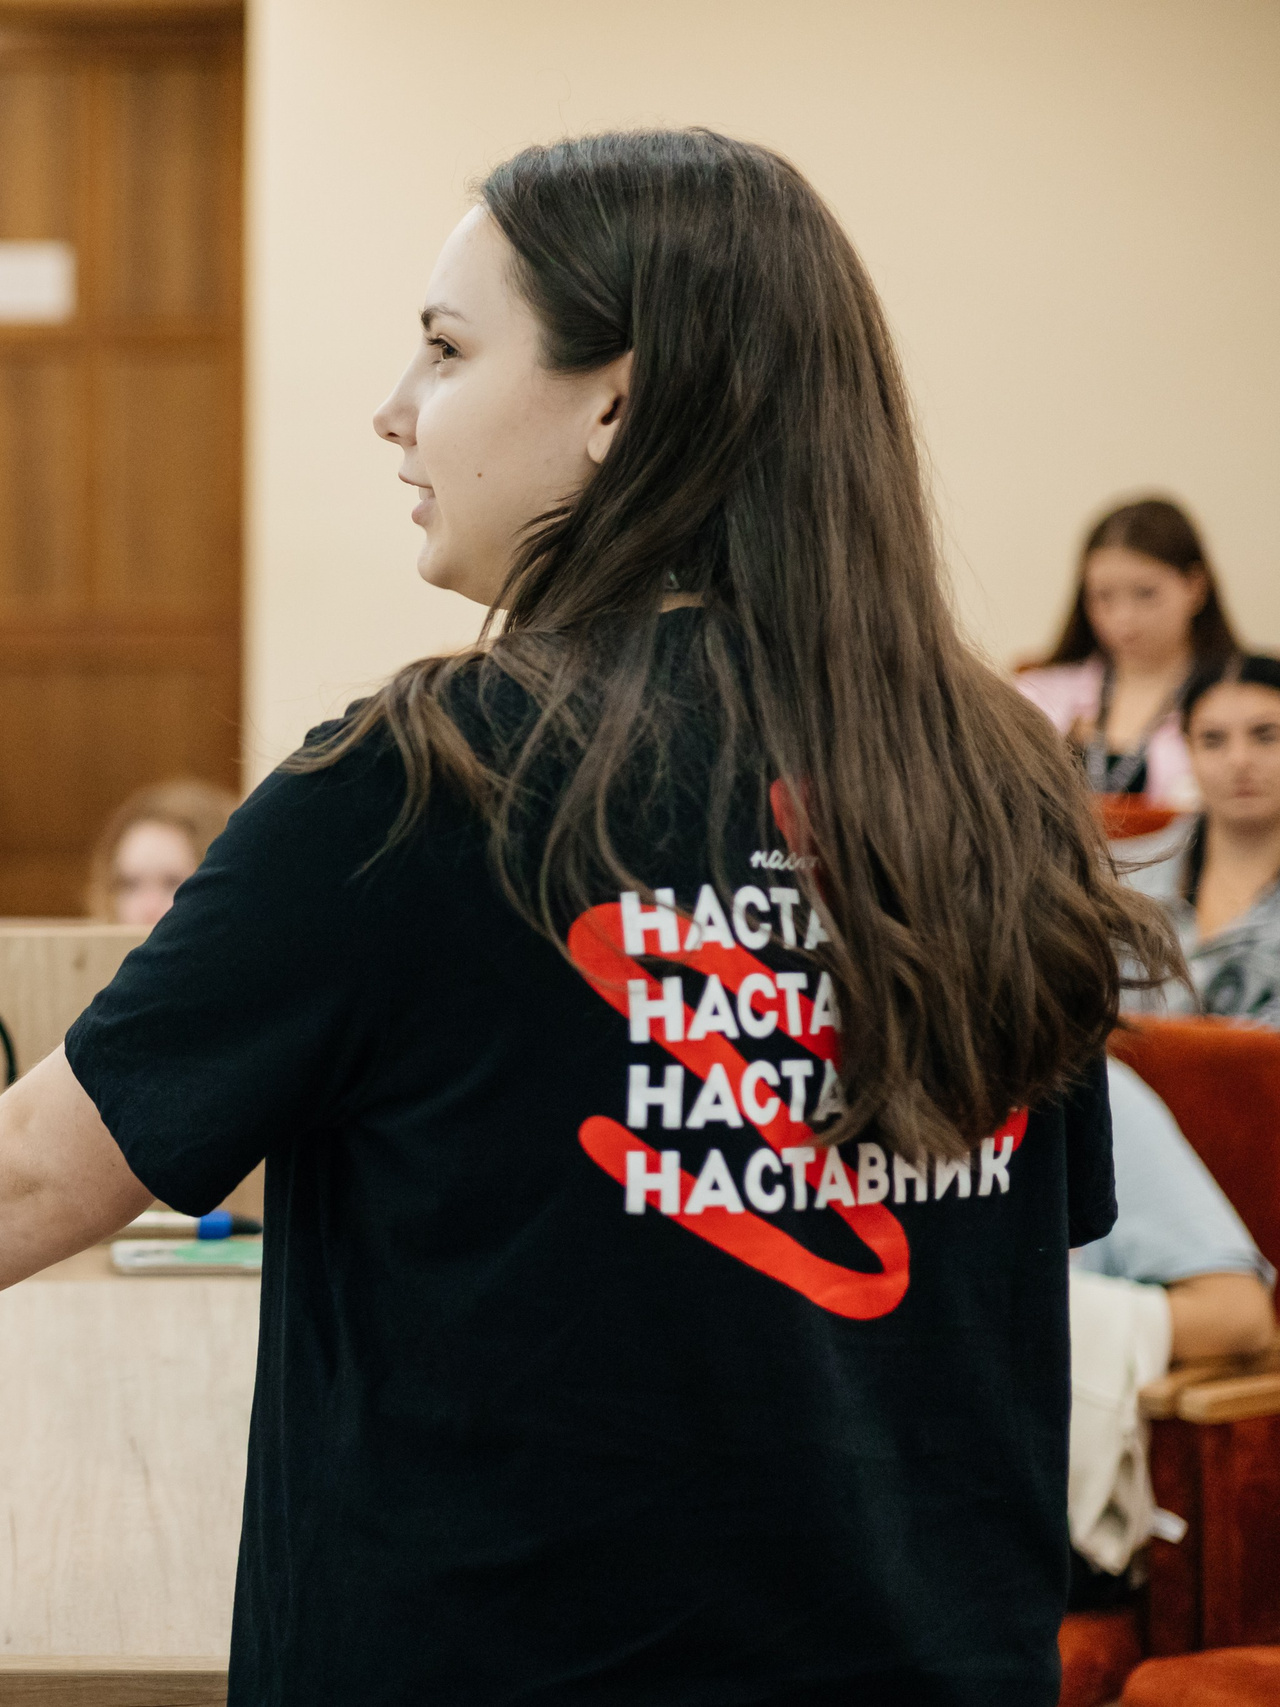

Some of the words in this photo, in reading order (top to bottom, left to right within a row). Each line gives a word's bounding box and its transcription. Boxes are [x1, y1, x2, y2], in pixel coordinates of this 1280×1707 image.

[620, 883, 831, 956] НАСТА
[627, 971, 843, 1044] НАСТА
[626, 1059, 845, 1130] НАСТА
[625, 1136, 1014, 1215] НАСТАВНИК
